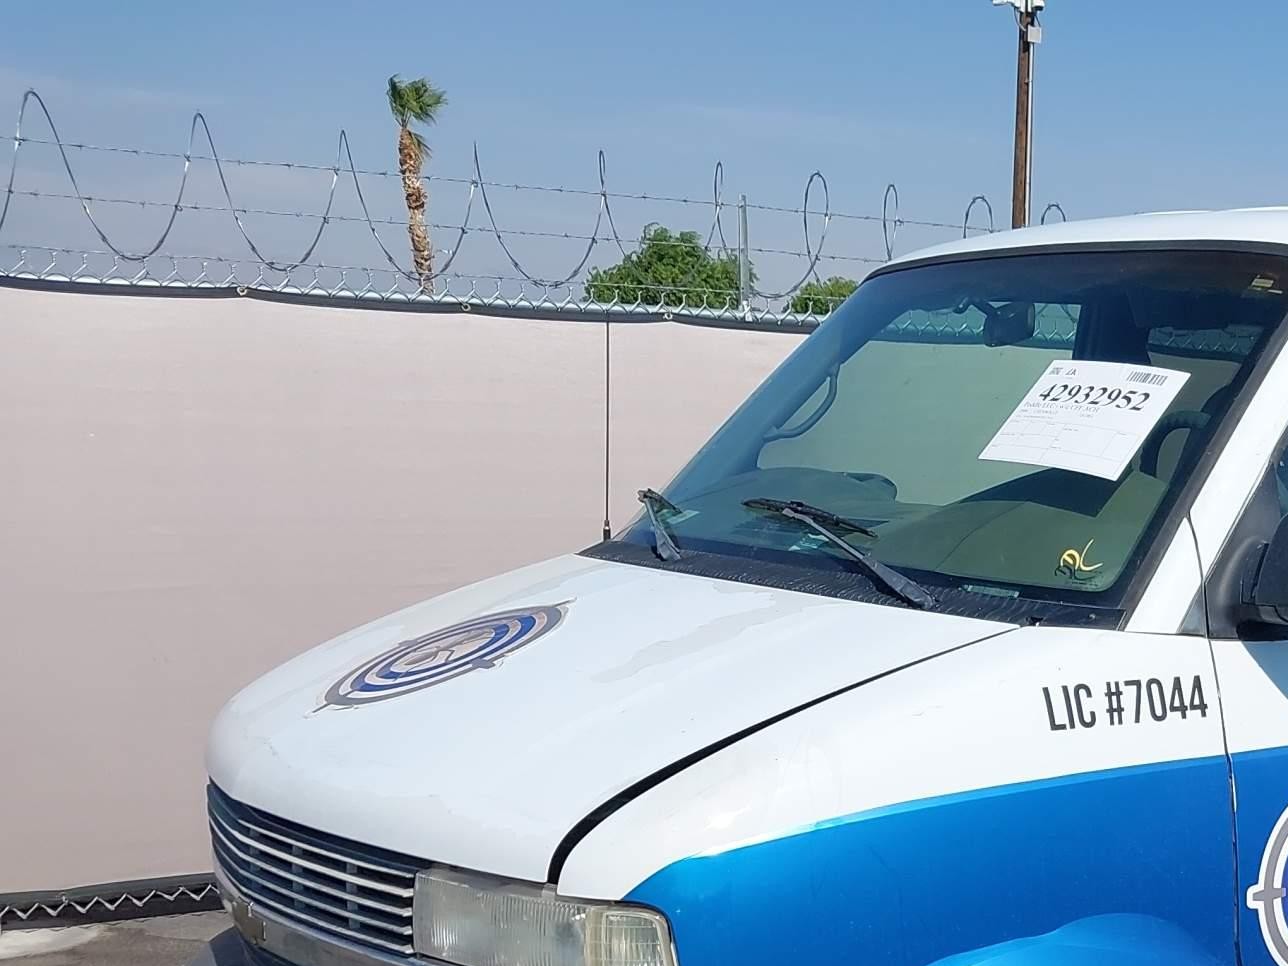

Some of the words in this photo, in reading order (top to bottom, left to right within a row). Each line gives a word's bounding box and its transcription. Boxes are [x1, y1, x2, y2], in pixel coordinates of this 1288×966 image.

[1039, 384, 1150, 411] 42932952
[1042, 683, 1097, 731] LIC
[1104, 675, 1209, 726] #7044
